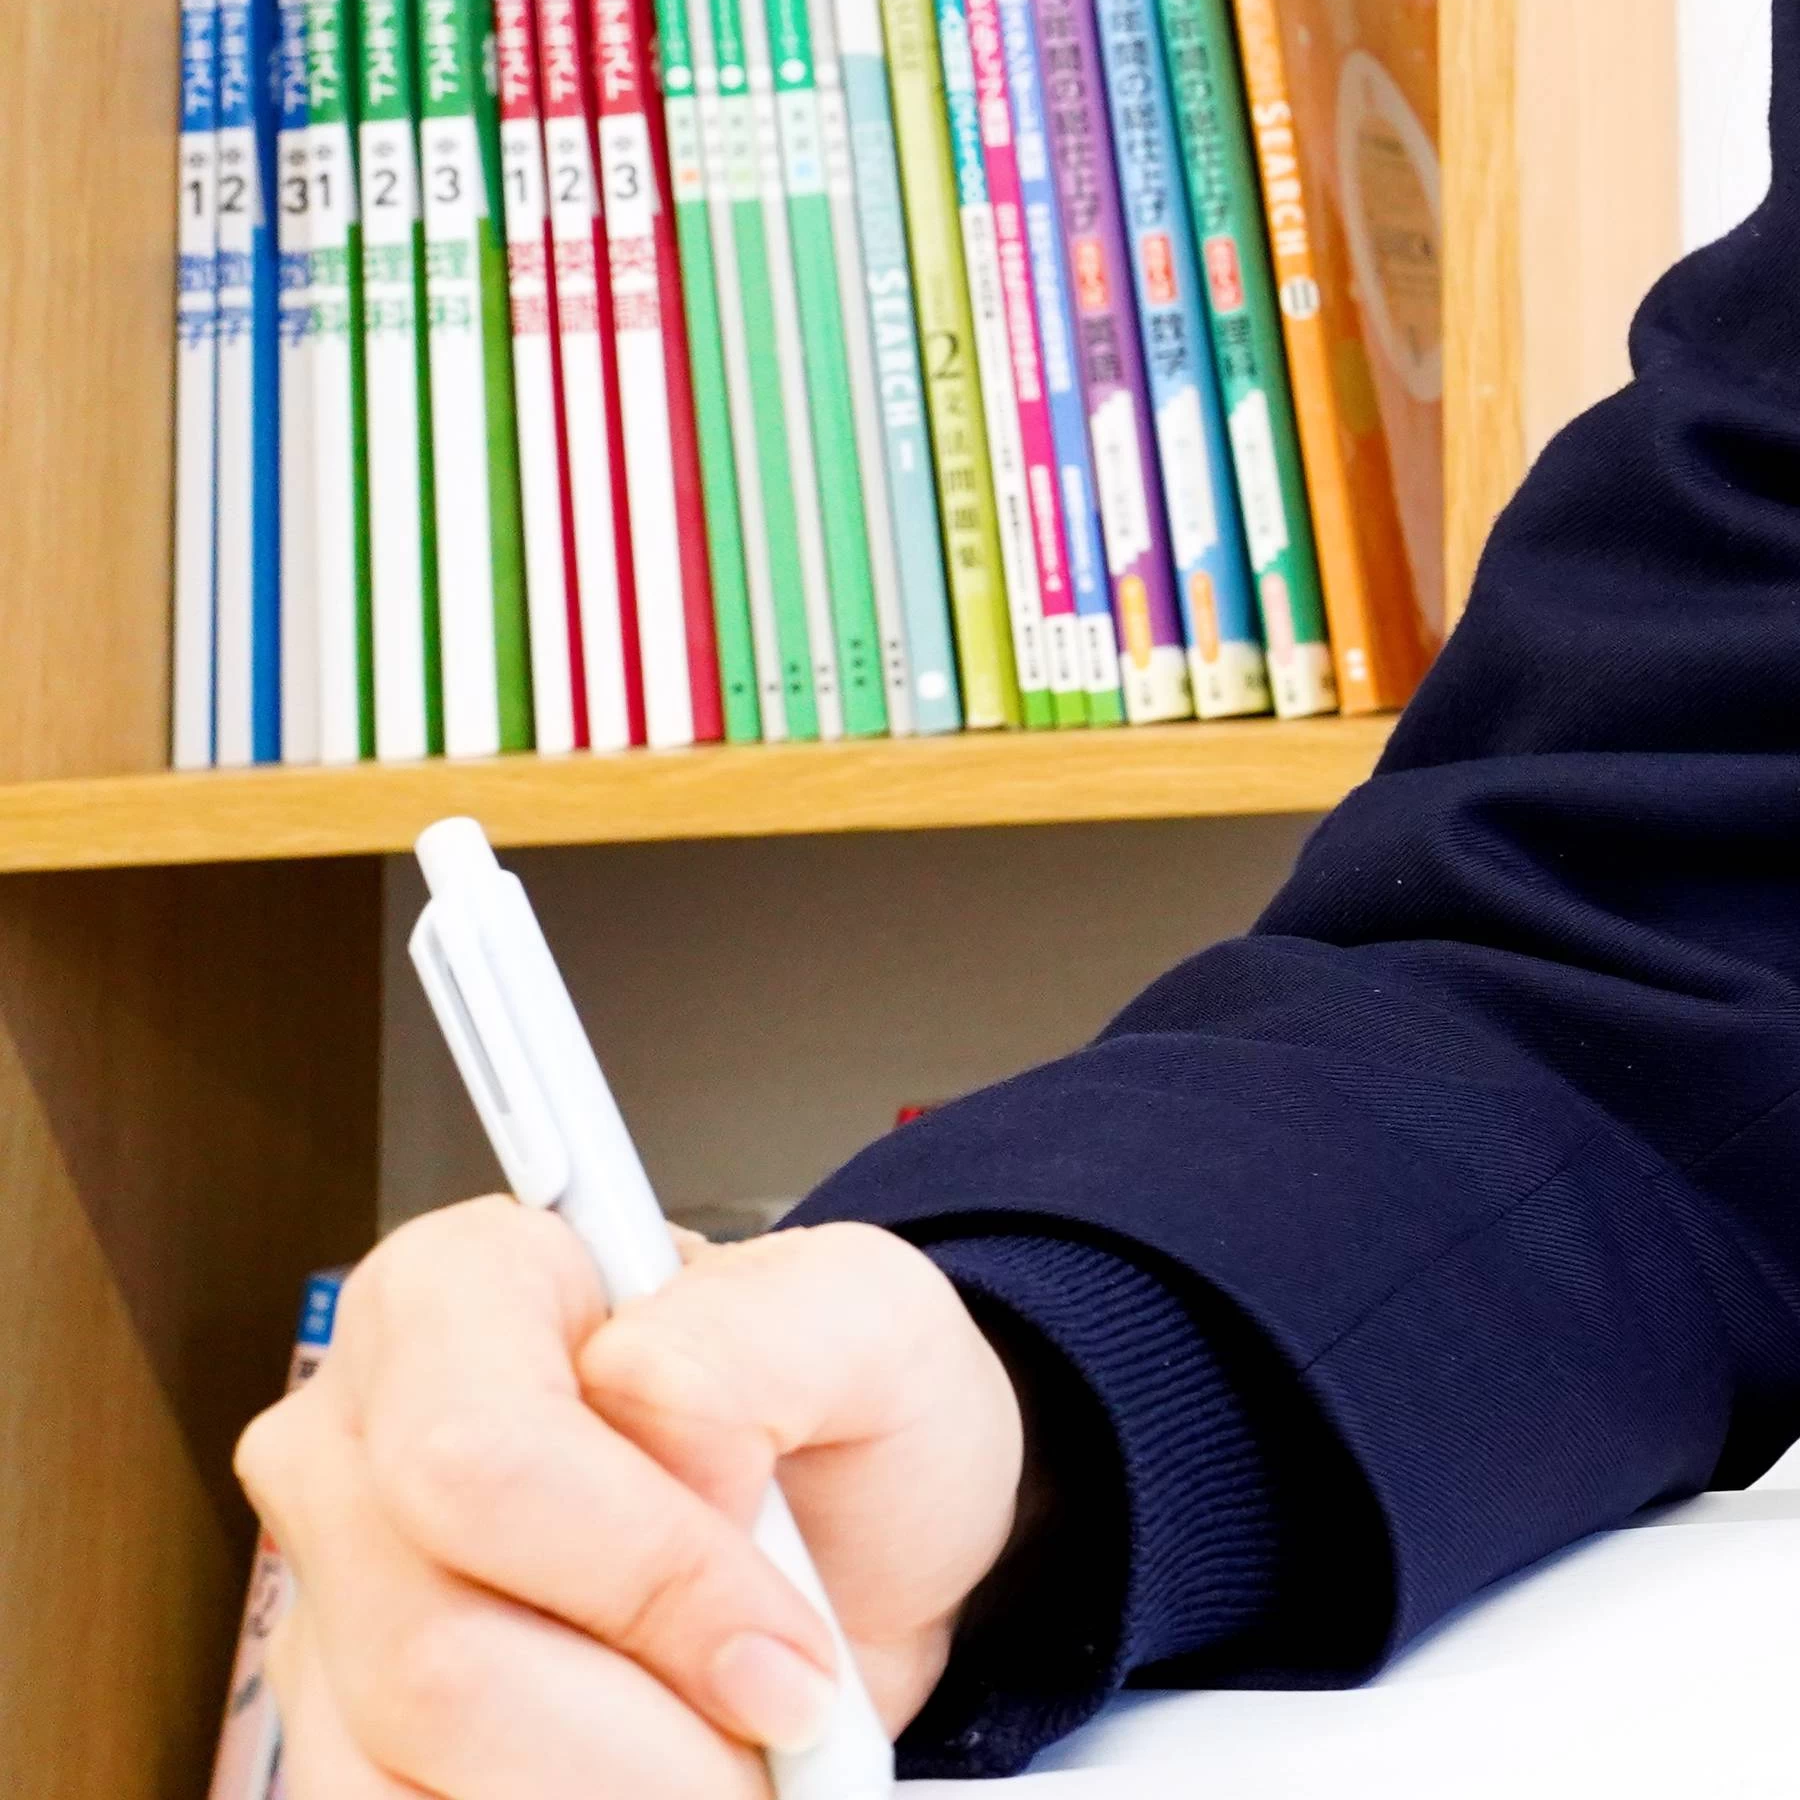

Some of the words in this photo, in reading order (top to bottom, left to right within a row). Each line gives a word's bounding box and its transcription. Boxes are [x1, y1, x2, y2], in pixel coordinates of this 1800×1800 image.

[1253, 102, 1308, 256] SEARCH
[179, 254, 214, 349] 数学
[217, 251, 251, 345] 数学
[311, 249, 347, 334] 理科
[367, 246, 410, 333] 理科
[428, 240, 470, 333] 理科
[509, 242, 548, 334] 英語
[554, 240, 595, 332] 英語
[609, 237, 657, 332] 英語
[866, 269, 919, 427] SEARCH
[926, 332, 962, 380] 2
